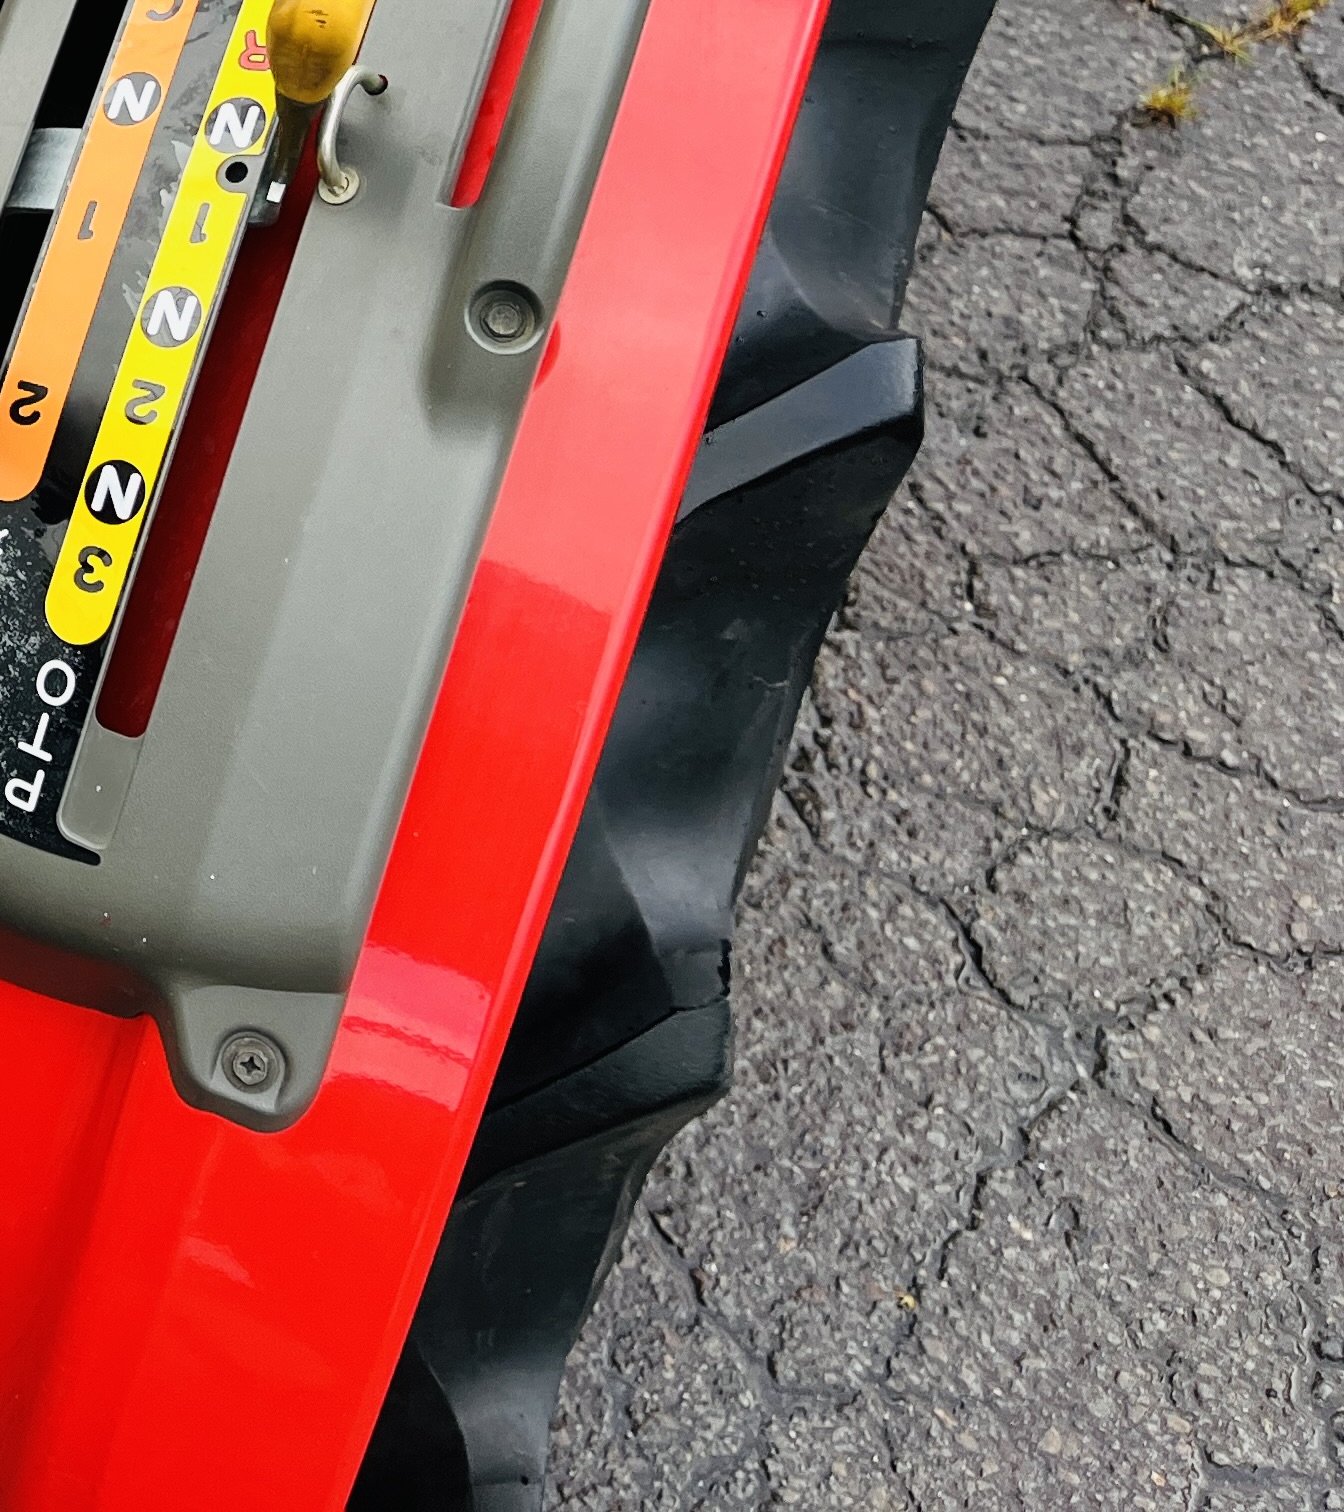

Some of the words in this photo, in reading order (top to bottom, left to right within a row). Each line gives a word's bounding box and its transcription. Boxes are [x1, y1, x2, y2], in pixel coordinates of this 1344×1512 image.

[237, 29, 269, 71] R
[110, 80, 156, 122] N
[212, 105, 262, 146] N
[76, 200, 96, 240] 1
[190, 203, 208, 245] 1
[145, 290, 198, 340] N
[9, 380, 49, 426] 2
[123, 380, 167, 425] 2
[89, 464, 141, 517] N
[72, 547, 114, 592] 3
[4, 657, 77, 814] PTO
